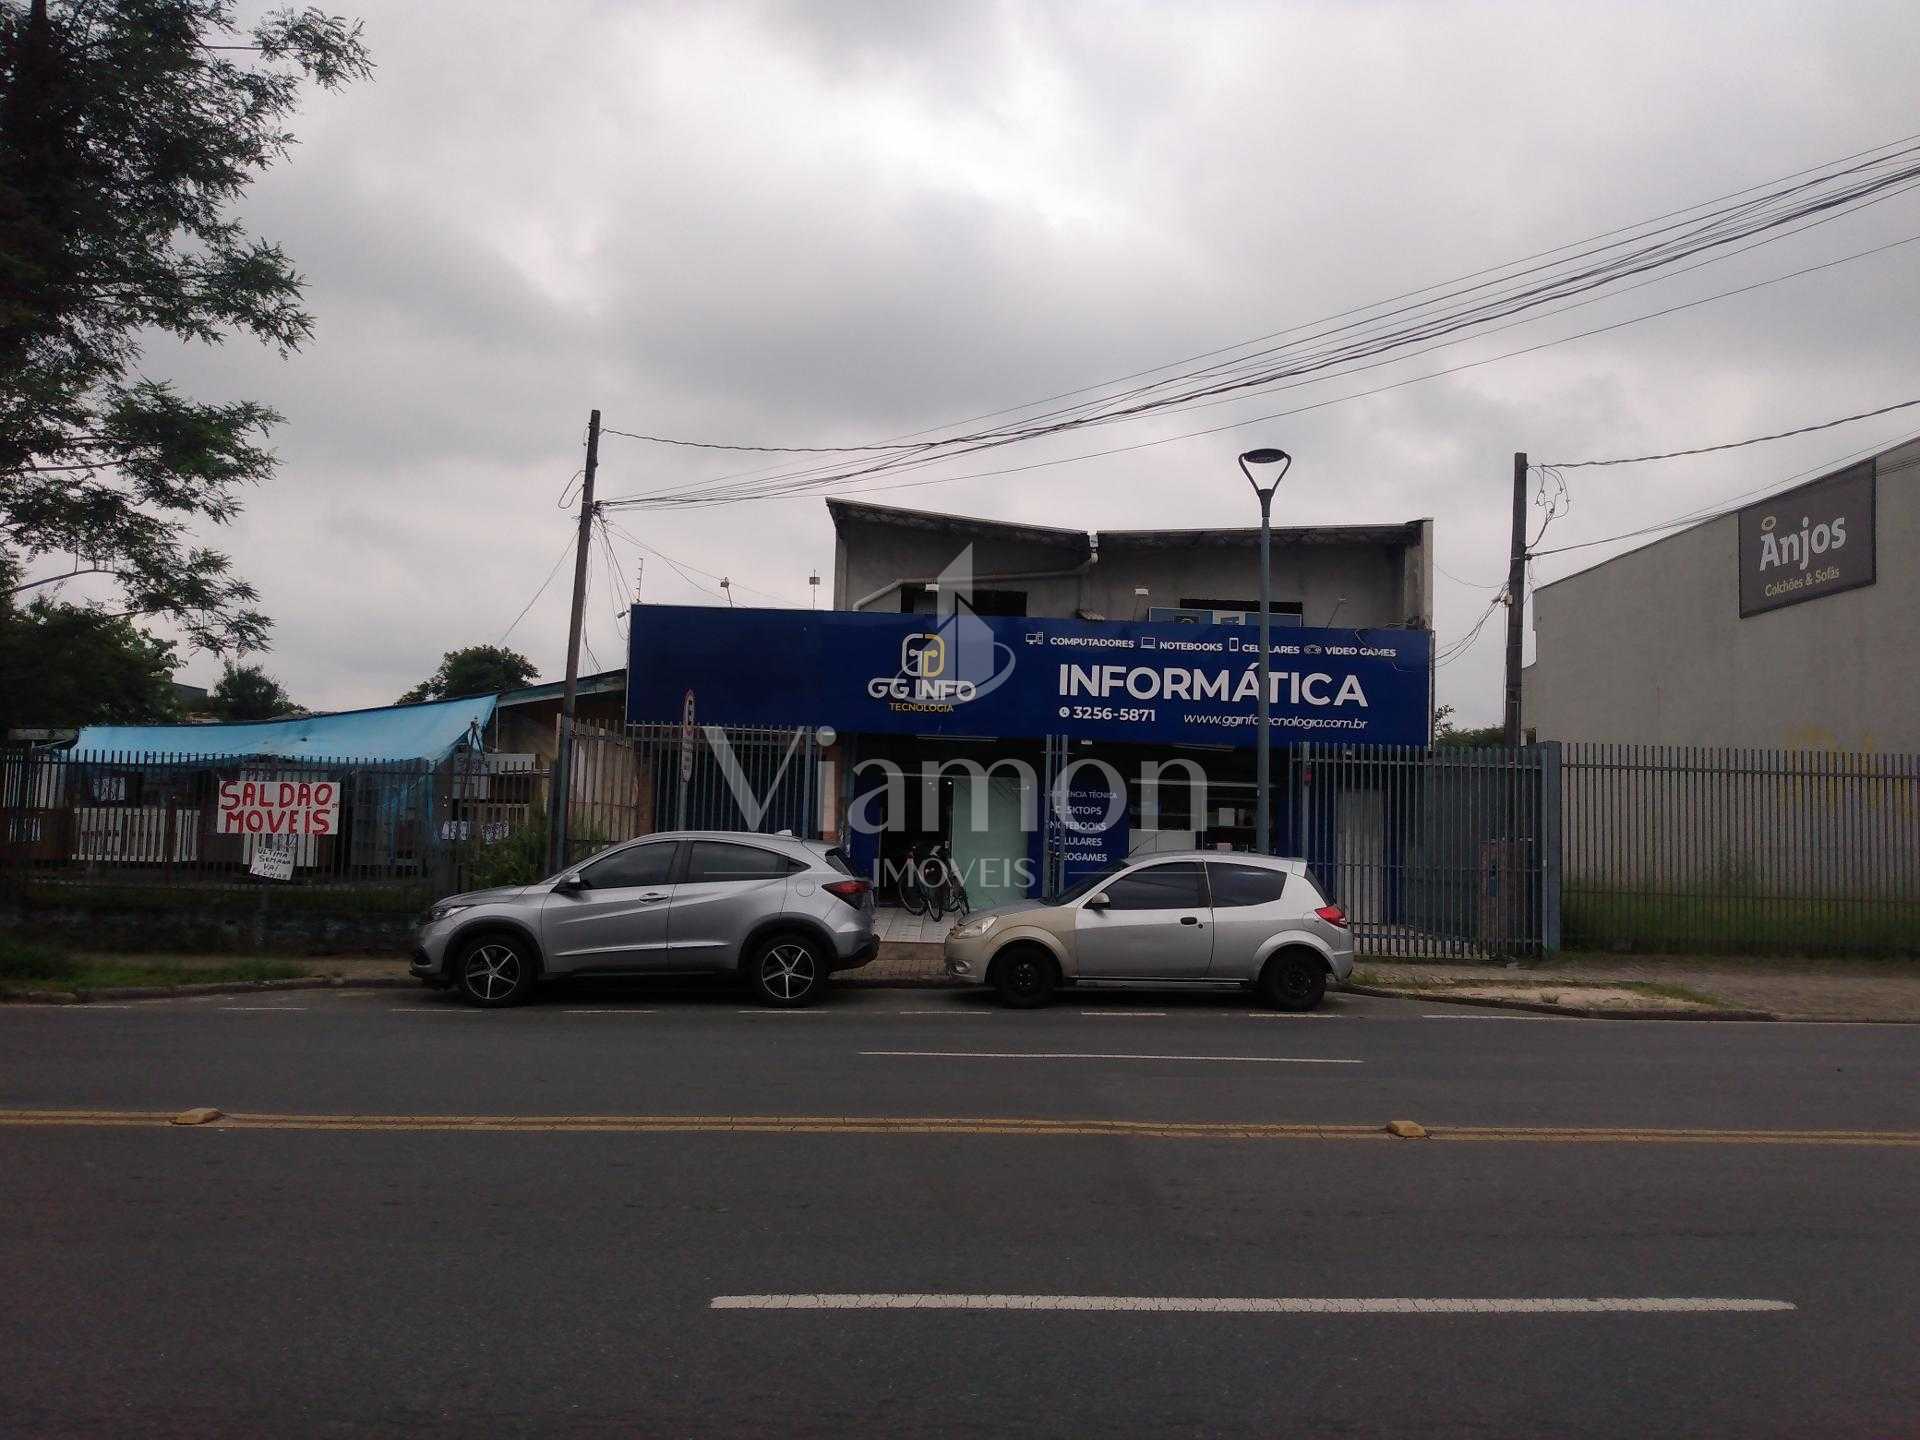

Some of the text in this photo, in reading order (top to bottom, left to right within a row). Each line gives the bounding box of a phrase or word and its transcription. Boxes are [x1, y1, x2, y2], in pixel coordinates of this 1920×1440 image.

[1760, 516, 1847, 572] Anjos
[1765, 578, 1803, 597] Colchões
[1806, 572, 1813, 586] &
[1050, 636, 1135, 649] COMPUTADORES
[1159, 641, 1223, 652] NOTEBOOKS
[1241, 644, 1300, 654] CELLARES
[1359, 648, 1397, 657] GAMES
[867, 678, 977, 702] GG INFO
[1059, 662, 1369, 707] INFORMÁTICA
[888, 702, 954, 712] TECNOLOGIA
[1072, 706, 1156, 722] 3256-5871
[1183, 713, 1369, 730] www.gginfoecnologia.com.br
